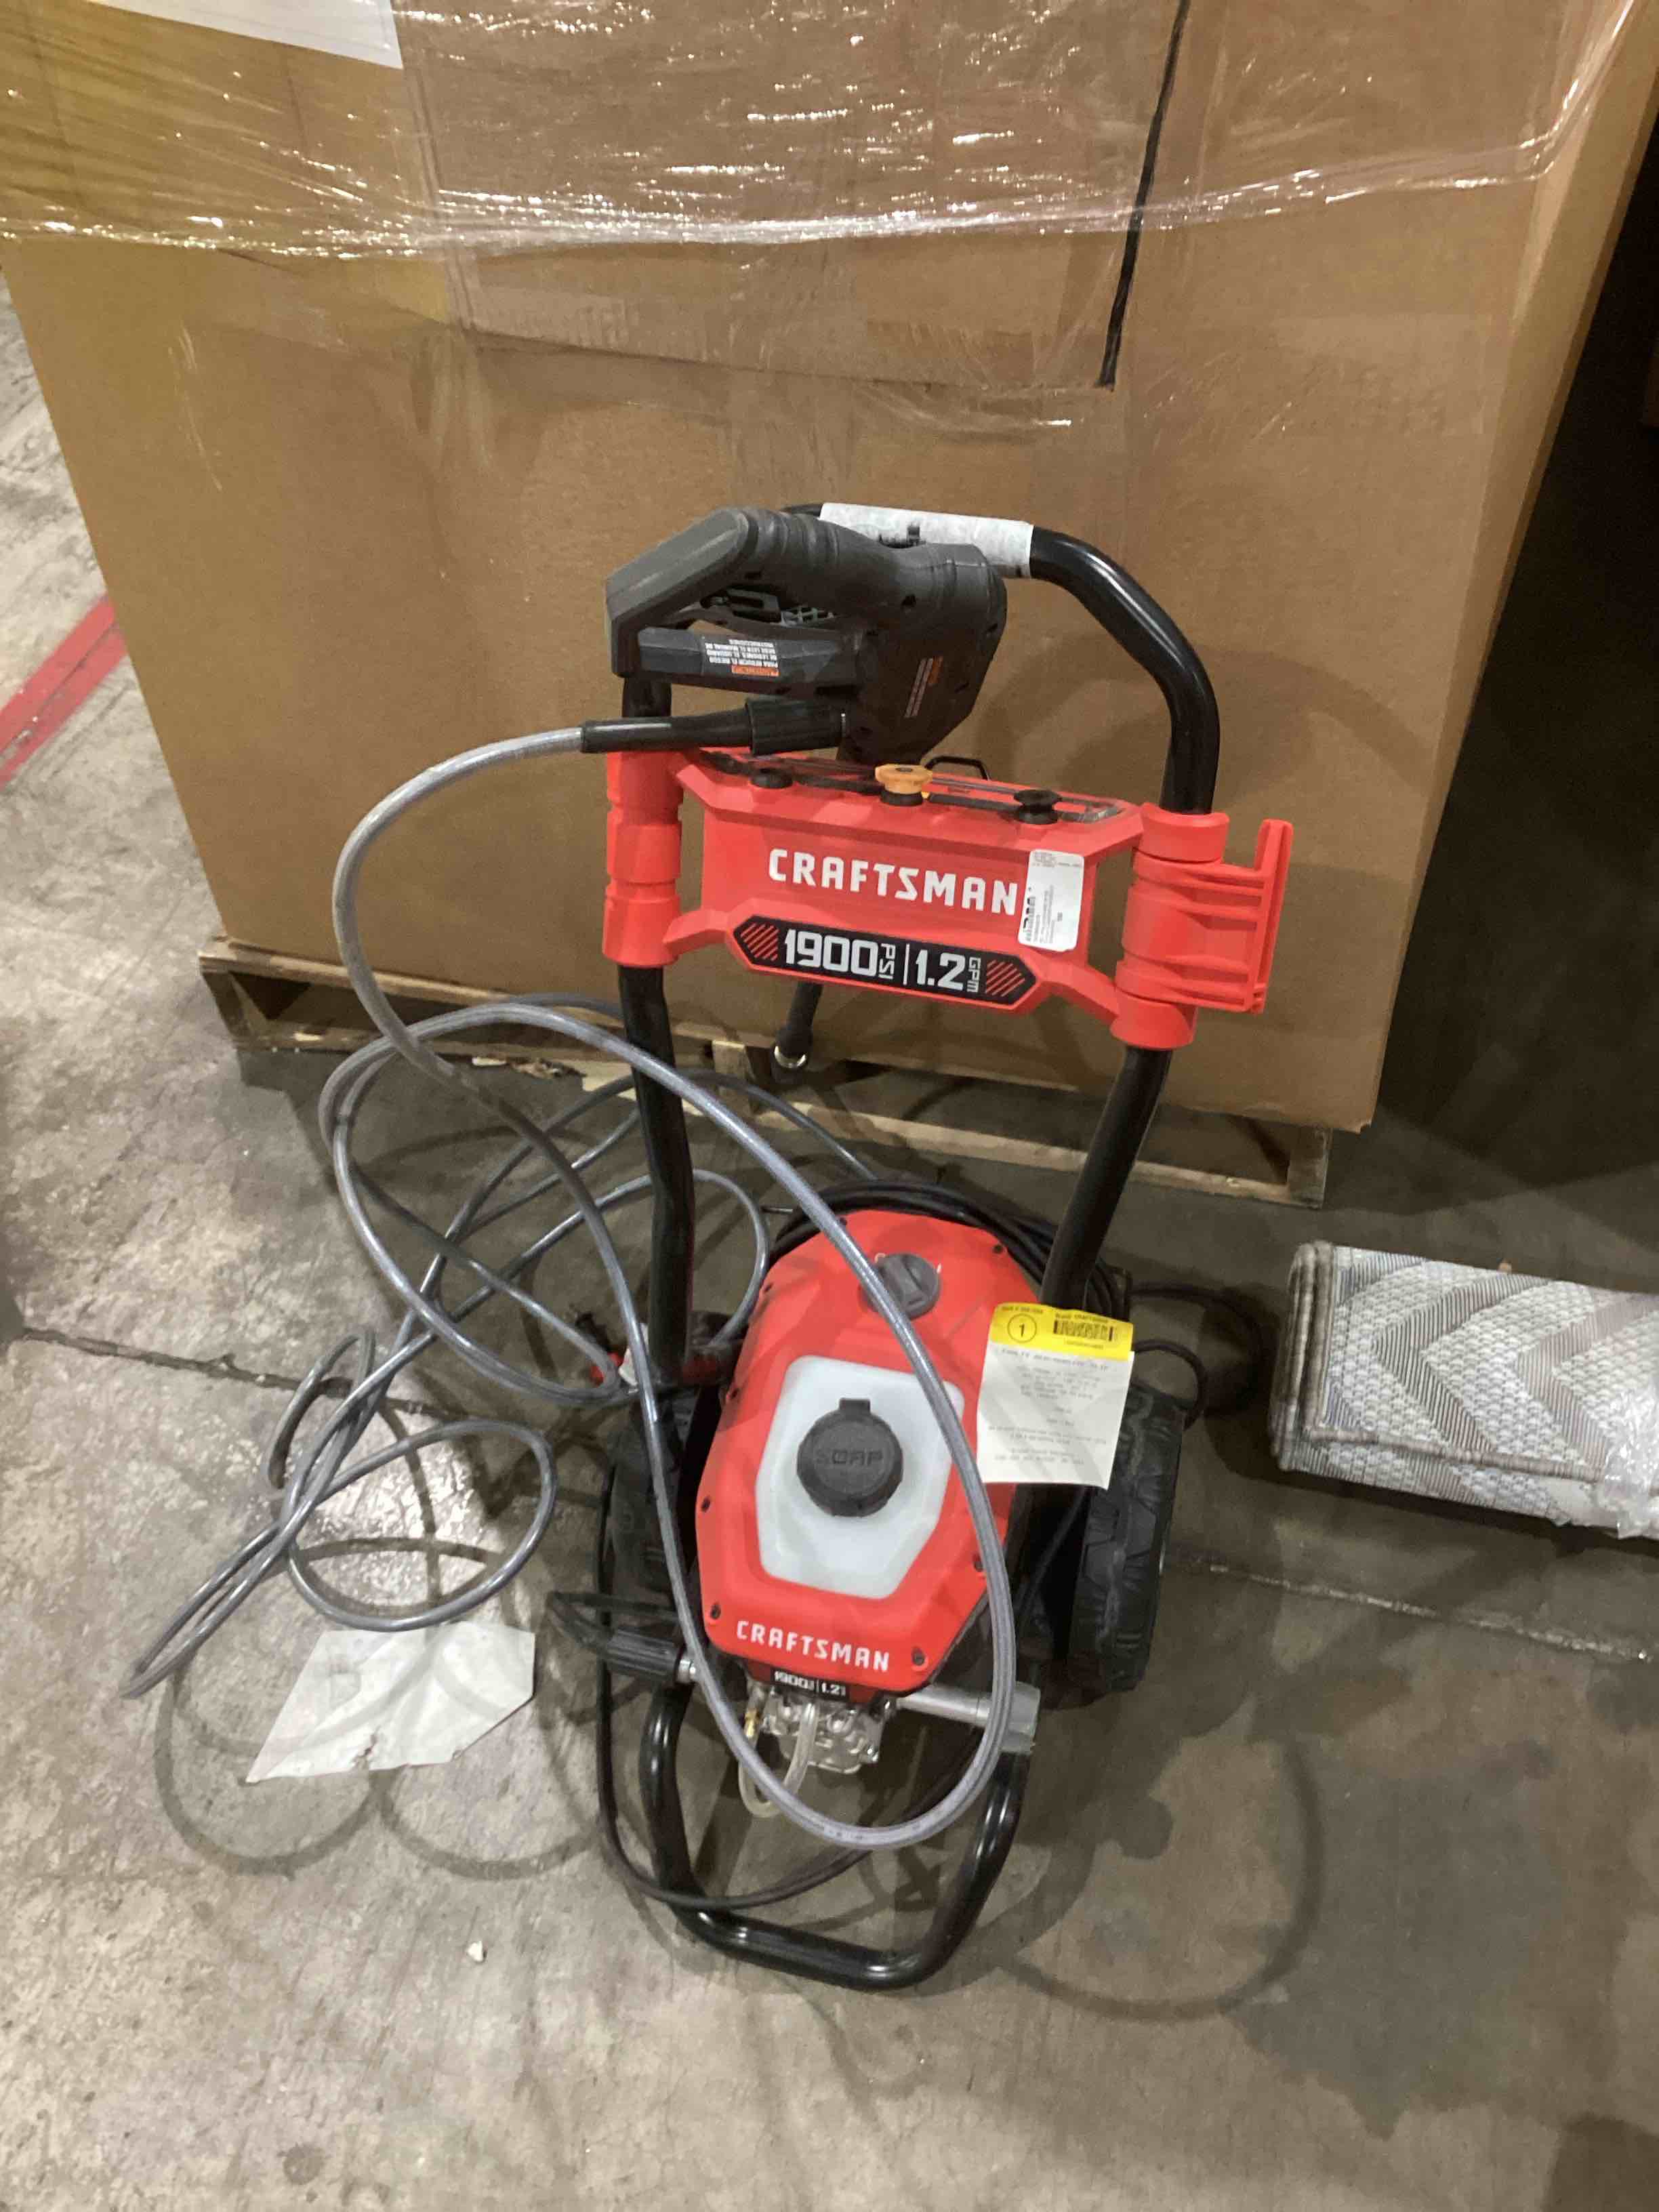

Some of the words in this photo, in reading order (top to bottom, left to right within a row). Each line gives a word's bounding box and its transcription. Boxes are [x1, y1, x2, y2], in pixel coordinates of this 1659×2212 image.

[769, 848, 1018, 916] CRAFTSMAN
[784, 928, 879, 977] 1900
[878, 943, 896, 980] PSI
[916, 949, 966, 991] 1.2
[1019, 1324, 1025, 1337] 1
[737, 1620, 890, 1672] CRAFTSMAN
